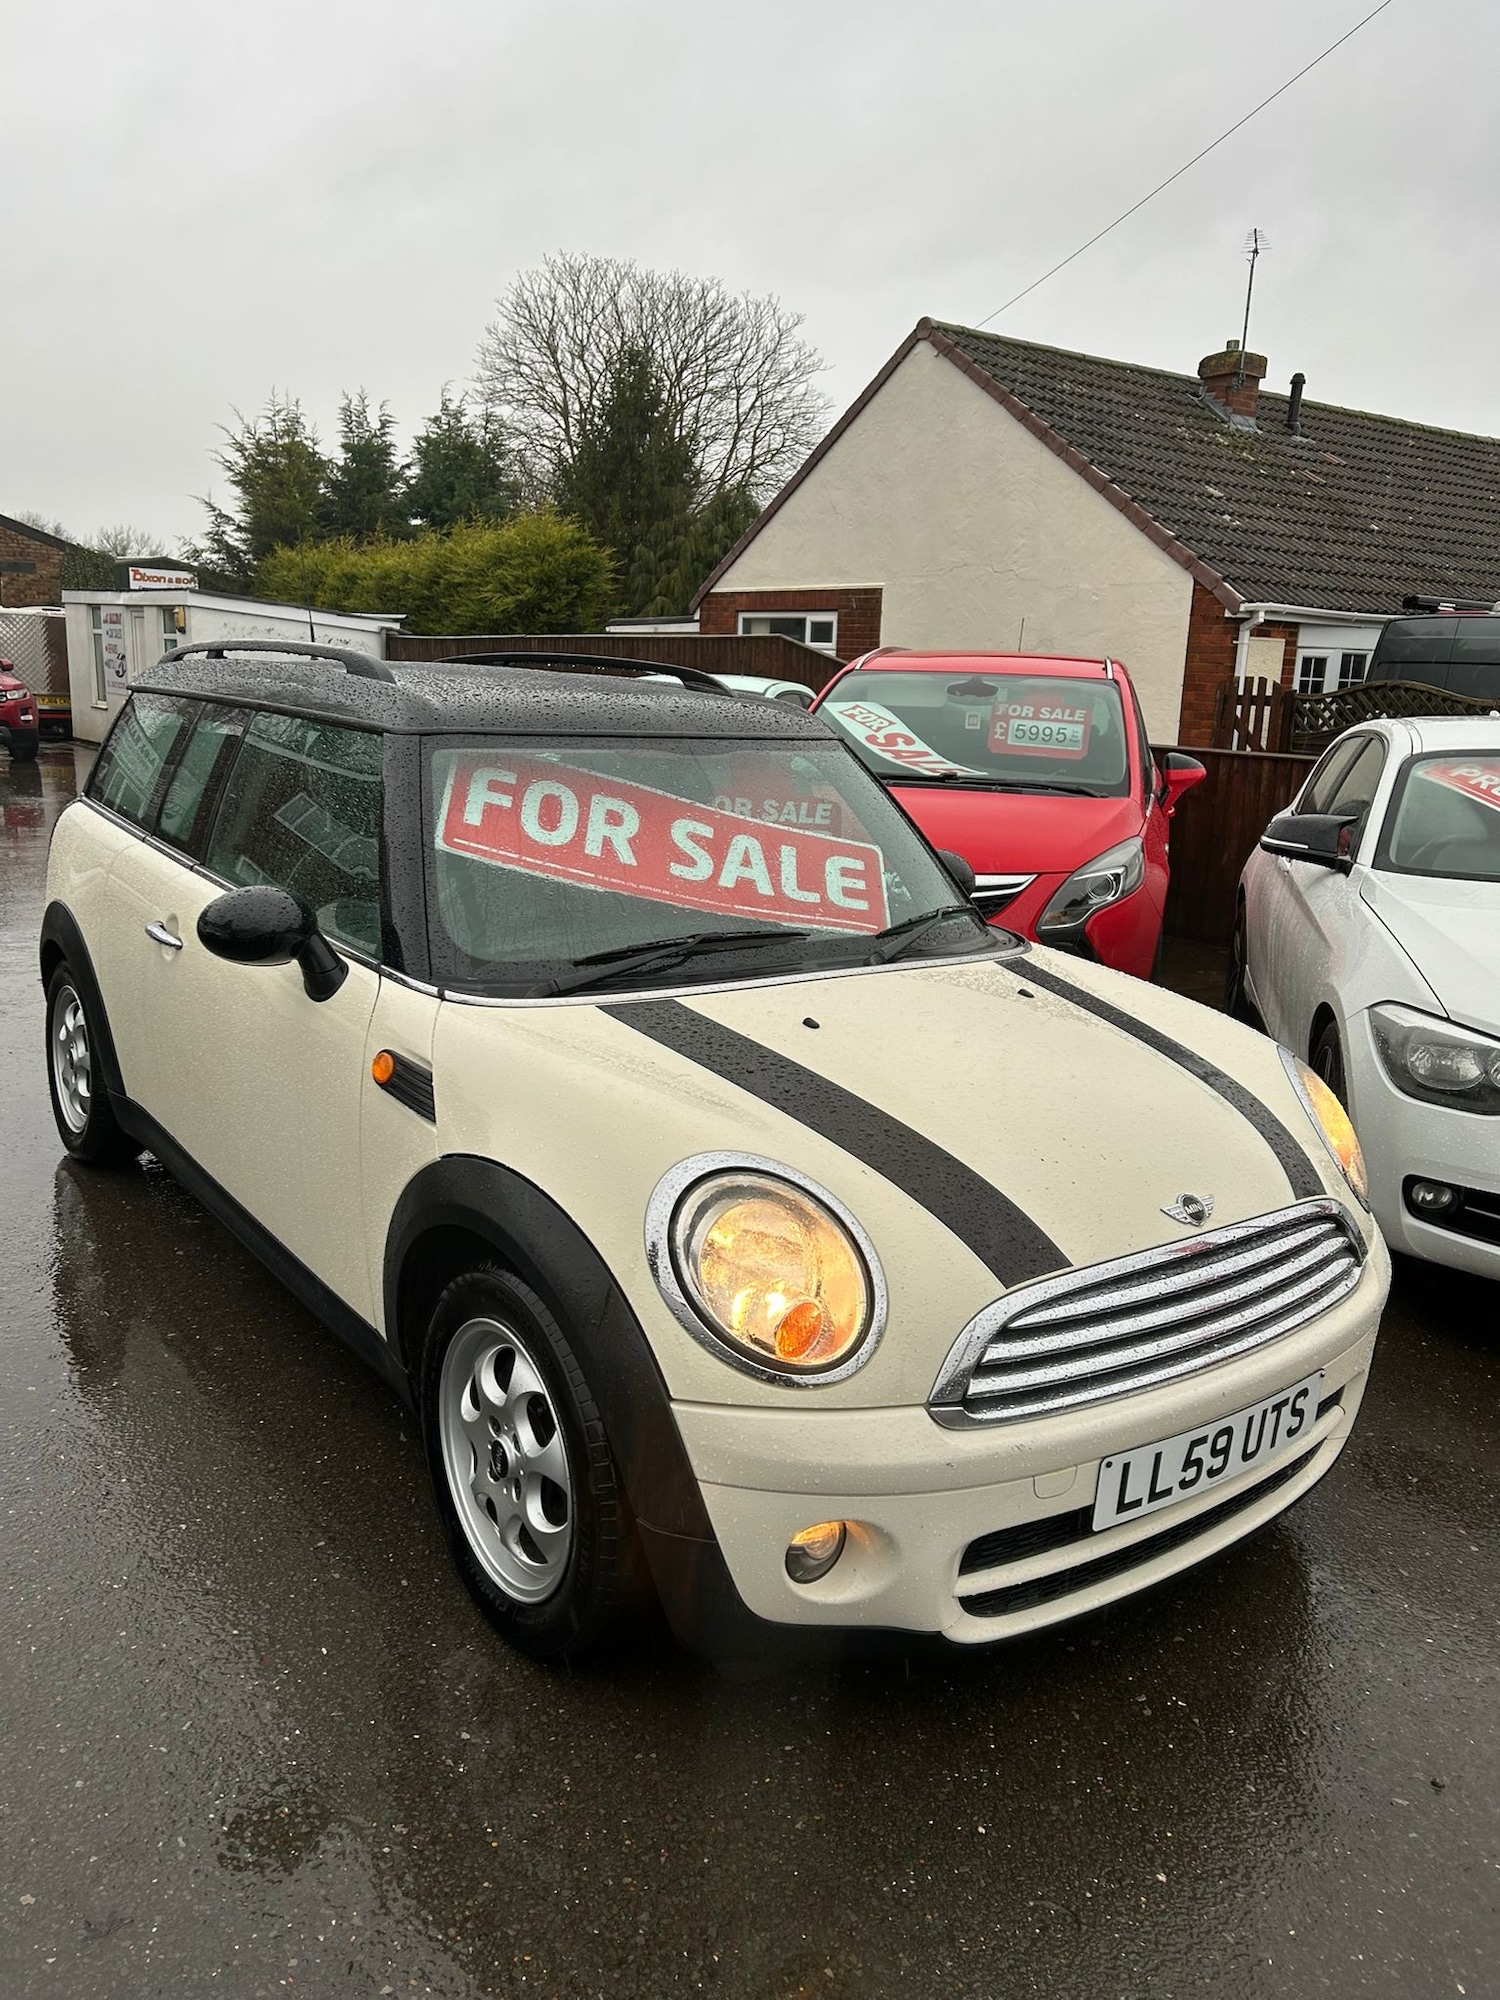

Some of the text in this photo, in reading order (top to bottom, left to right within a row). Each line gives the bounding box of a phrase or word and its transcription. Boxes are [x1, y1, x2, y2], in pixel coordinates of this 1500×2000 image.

[842, 706, 890, 732] FOR
[996, 704, 1087, 721] FOR SALE
[1014, 724, 1067, 743] 5995
[865, 732, 975, 775] SALE
[713, 795, 833, 825] OR SALE
[463, 767, 870, 911] FOR SALE
[1116, 1386, 1309, 1516] LL59 UTS
